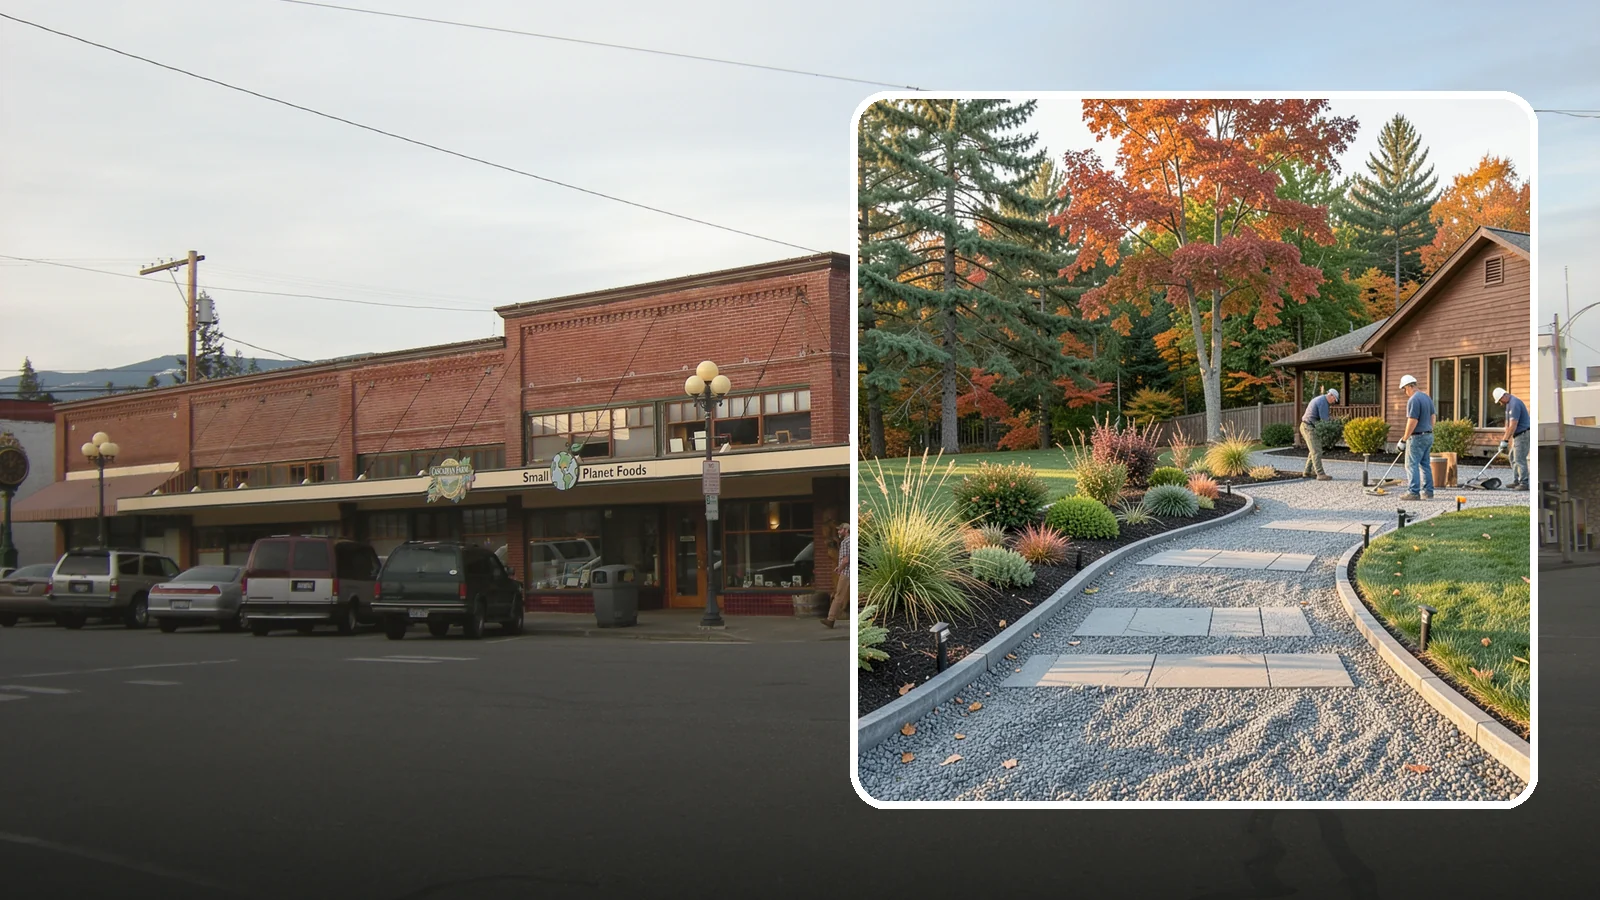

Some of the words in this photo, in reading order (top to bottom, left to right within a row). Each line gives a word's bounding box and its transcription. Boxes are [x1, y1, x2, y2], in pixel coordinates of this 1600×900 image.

[523, 471, 549, 483] Small
[583, 467, 614, 479] Planet
[616, 465, 647, 477] Foods
